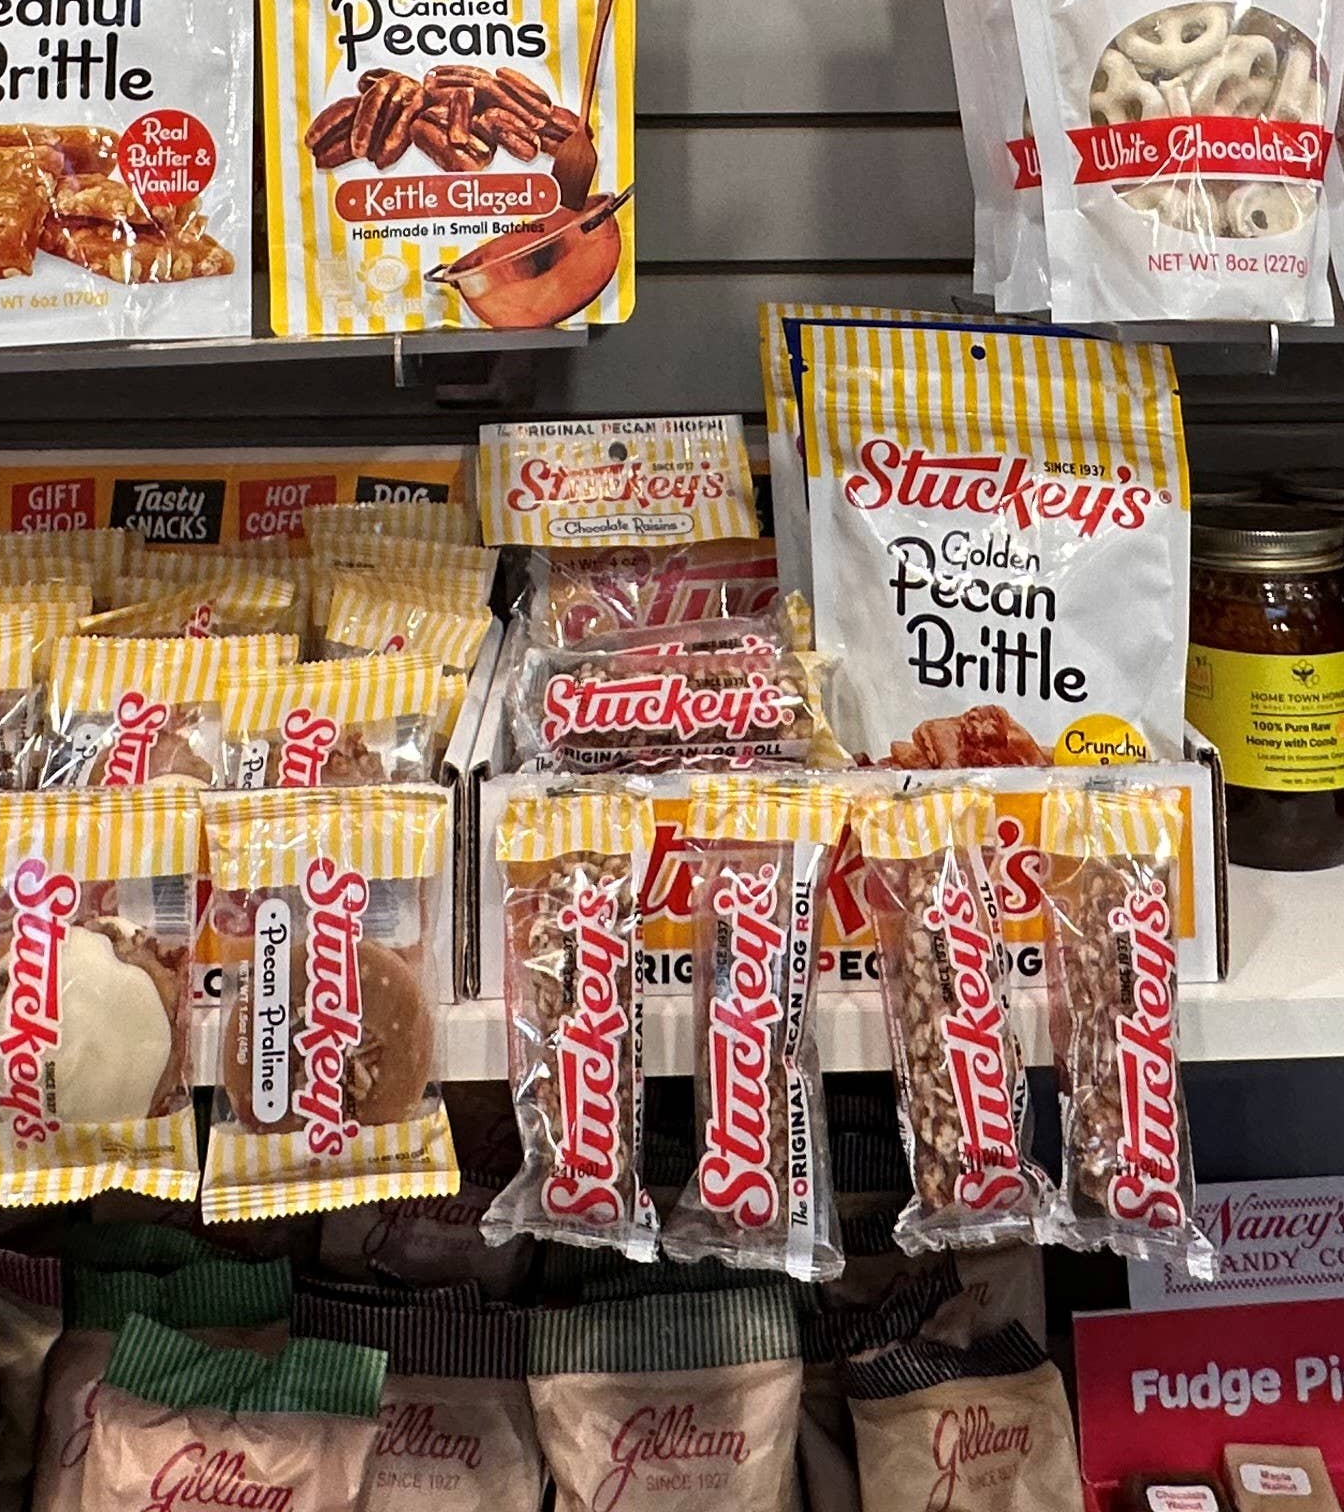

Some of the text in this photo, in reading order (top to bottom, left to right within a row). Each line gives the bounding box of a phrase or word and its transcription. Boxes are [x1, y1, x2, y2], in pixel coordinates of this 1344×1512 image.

[141, 118, 189, 145] Real
[1092, 126, 1302, 174] White Chocolate
[128, 145, 212, 171] Butter &
[132, 168, 201, 198] Vanilla
[363, 177, 533, 214] Kettle Glazed
[352, 223, 429, 241] Handmade
[449, 221, 487, 237] Small
[492, 220, 545, 235] Batches
[1147, 250, 1308, 277] NET WT 8oz (227g)
[845, 438, 1152, 538] Stuckey's
[564, 517, 678, 536] Chocolate Raisins
[941, 530, 1040, 572] Golden
[886, 536, 1055, 621] Pecan
[908, 613, 1088, 703] Brittle
[543, 675, 782, 743] Stuckey's
[1251, 692, 1284, 702] HOME
[1287, 693, 1320, 703] TOWN
[1246, 736, 1337, 749] Honey with Comb
[1253, 721, 1331, 732] 100% Pure Raw
[794, 881, 811, 932] ROLL
[792, 939, 808, 985] LOG
[258, 924, 287, 1093] Pecan Praline
[294, 857, 368, 1157] Stuckey's
[544, 875, 628, 1225] Stuckey's
[701, 870, 785, 1228] Stuckey's
[923, 883, 1026, 1211] Stuckey's
[1113, 891, 1184, 1230] Stuckey's
[791, 1076, 810, 1196] ORIGINAL
[791, 1200, 810, 1227] The
[1220, 1248, 1300, 1275] ANDY
[1131, 1362, 1282, 1417] Fudge
[593, 1404, 750, 1512] Gilliam
[926, 1407, 1032, 1512] Gilliam
